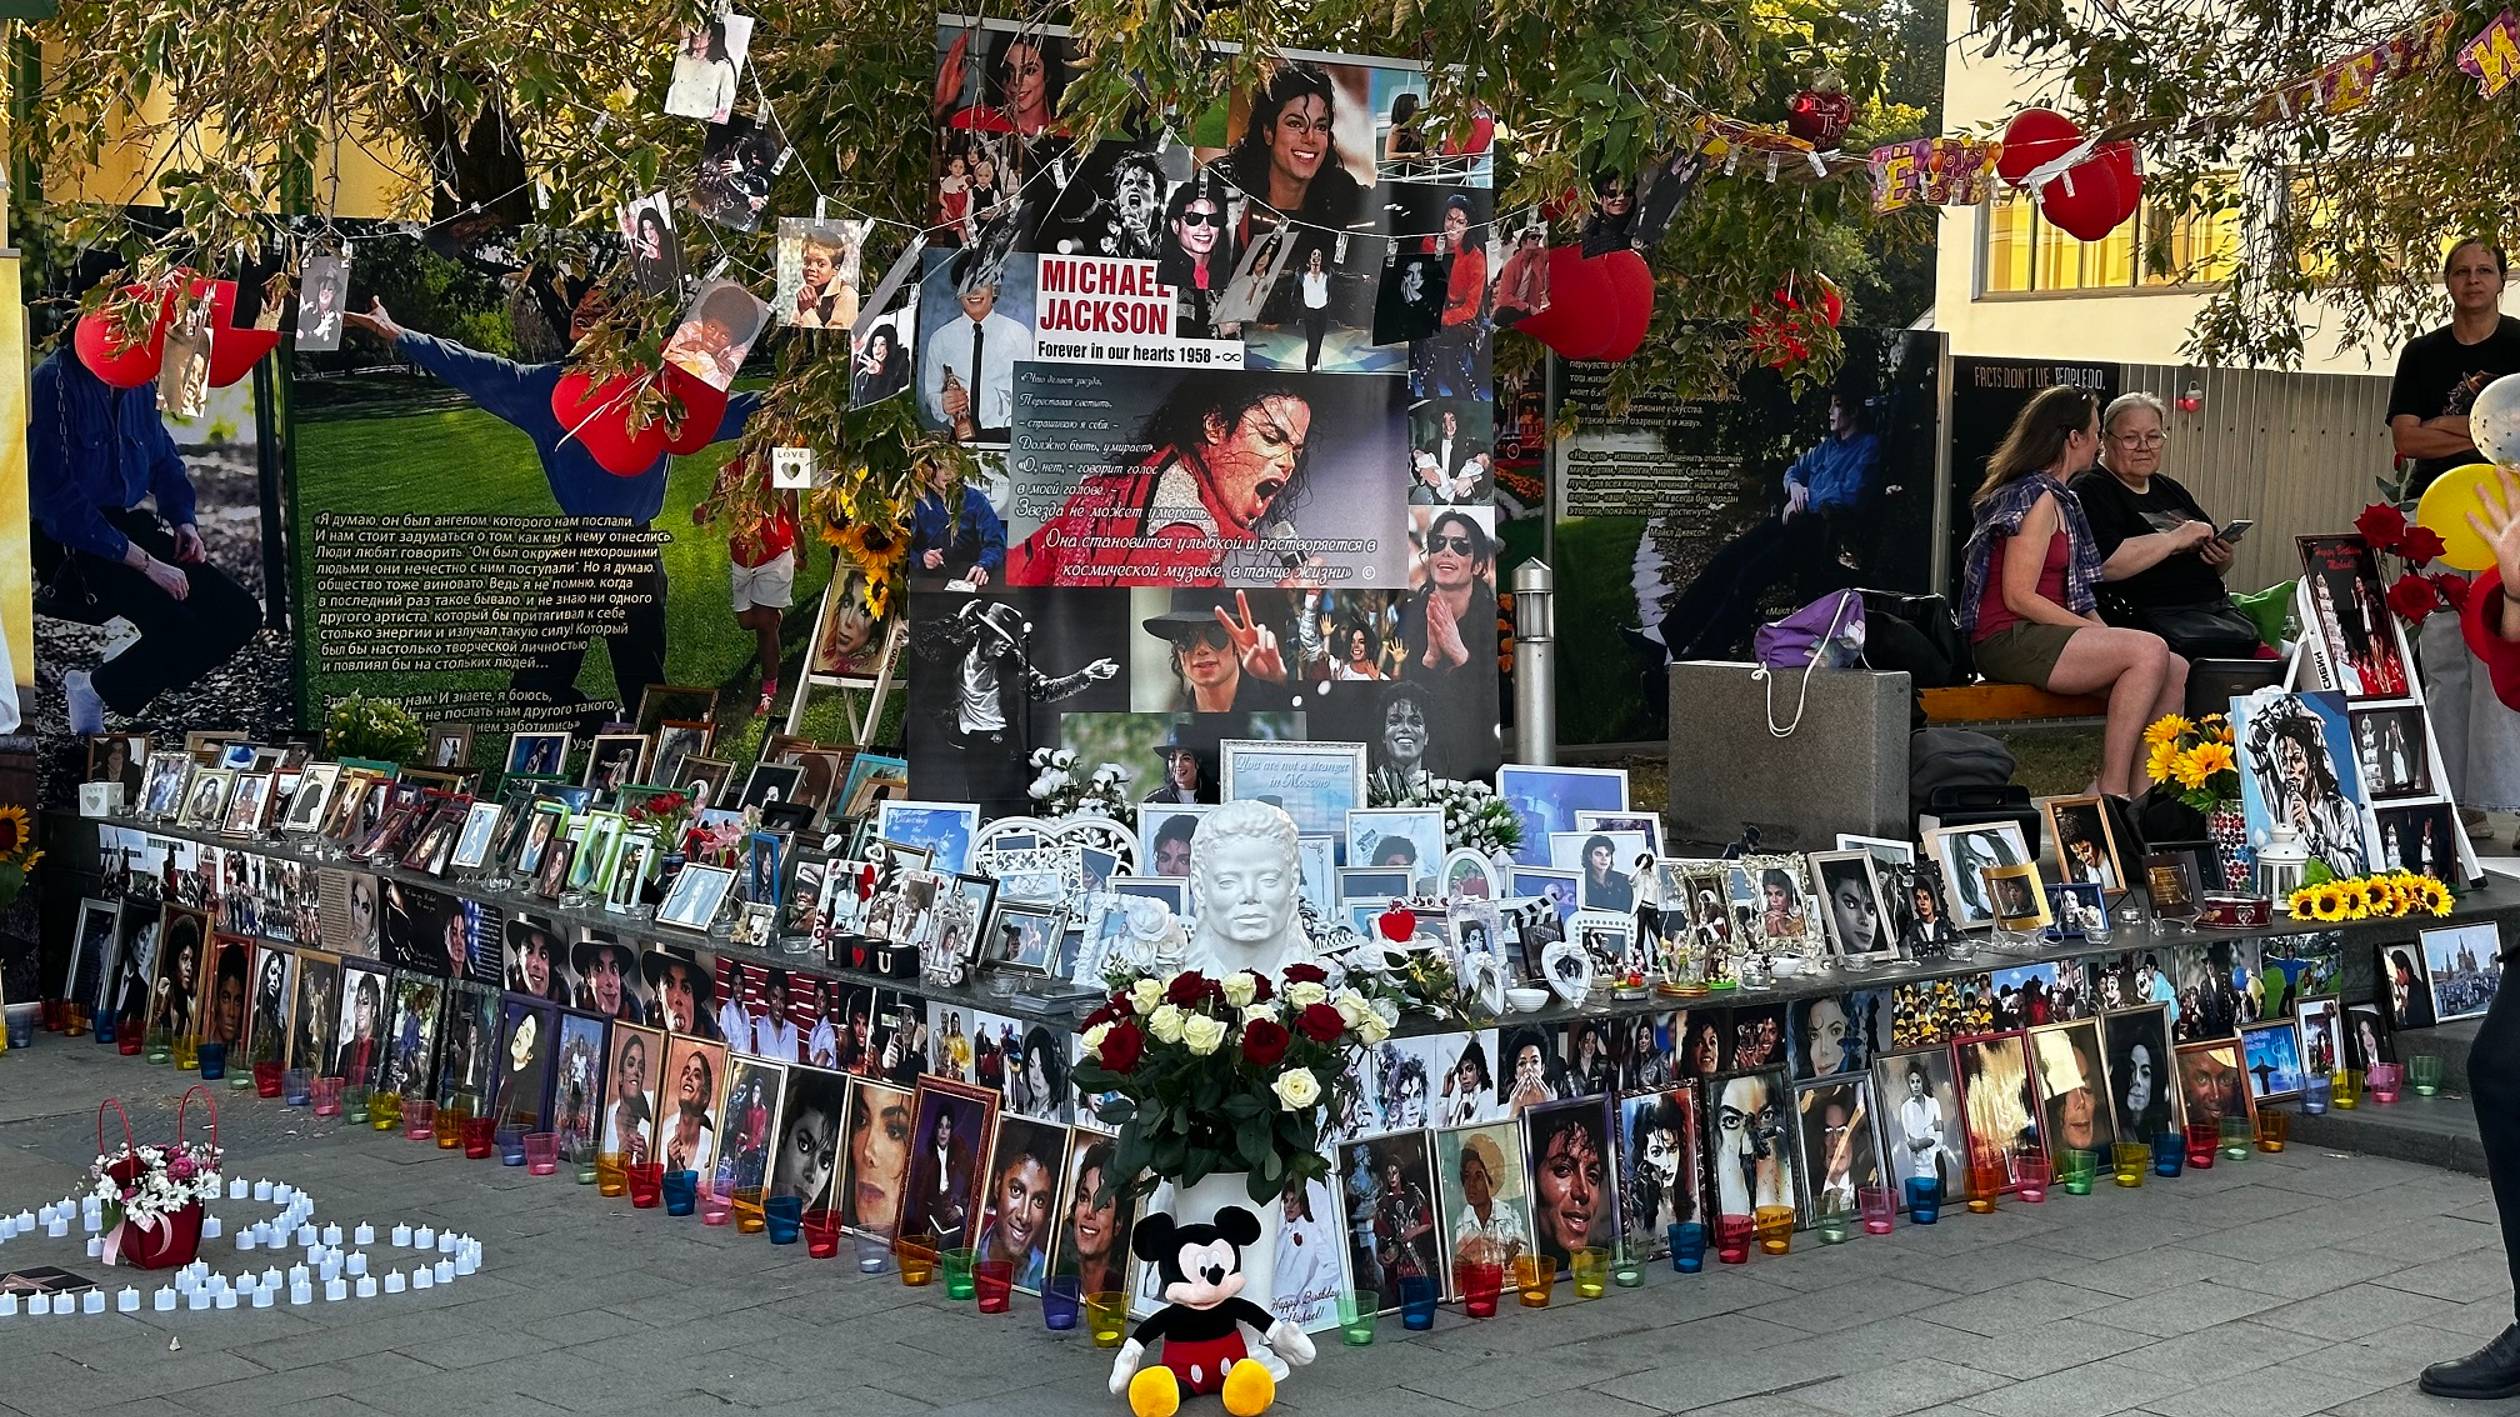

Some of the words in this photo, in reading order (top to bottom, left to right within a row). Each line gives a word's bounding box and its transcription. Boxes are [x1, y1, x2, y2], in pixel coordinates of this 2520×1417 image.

[1041, 259, 1170, 298] MICHAE
[1040, 299, 1169, 336] JACKSON
[1038, 341, 1087, 358] Forever
[1090, 343, 1104, 358] in
[1107, 346, 1130, 360] our
[1133, 345, 1175, 362] hearts
[1180, 348, 1211, 364] 1958
[1974, 366, 2002, 387] FACTS
[2004, 367, 2031, 388] DON'T
[1079, 421, 1086, 429] я
[1018, 435, 1067, 451] Должно
[1069, 440, 1099, 452] быть,
[1040, 463, 1065, 474] нет,
[1077, 463, 1123, 475] говорит
[1127, 464, 1159, 475] голос
[1016, 484, 1024, 495] в
[1029, 483, 1060, 495] моей
[1016, 498, 1063, 521] Звезда
[1069, 505, 1085, 518] не
[1090, 502, 1142, 518] может
[1148, 507, 1211, 520] умереть.
[382, 516, 400, 526] он
[403, 514, 430, 526] был
[493, 517, 551, 529] которого
[554, 518, 579, 526] нам
[315, 530, 326, 541] И
[329, 531, 354, 542] нам
[358, 531, 395, 542] стоит
[400, 532, 474, 545] задуматься
[477, 532, 486, 542] о
[518, 533, 540, 543] как
[543, 533, 562, 543] мы
[564, 533, 572, 542] к
[575, 532, 606, 544] нему
[1046, 528, 1077, 548] Она
[1082, 536, 1171, 549] становится
[1177, 535, 1241, 554] улыбкой
[1245, 541, 1255, 549] и
[1258, 539, 1362, 555] растворяется
[1367, 540, 1377, 552] в
[315, 545, 350, 560] Люди
[493, 546, 518, 558] был
[522, 549, 576, 561] окружен
[580, 547, 658, 560] нехорошими
[375, 564, 400, 574] они
[404, 563, 467, 575] нечестно
[470, 564, 477, 573] с
[479, 563, 505, 573] ним
[583, 561, 600, 573] Но
[603, 563, 611, 573] я
[1063, 561, 1160, 577] космической
[1164, 565, 1225, 583] музыке,
[1231, 567, 1239, 578] в
[1243, 566, 1291, 582] танце
[1294, 564, 1352, 585] жизни»
[317, 579, 382, 592] общество
[385, 582, 419, 591] тоже
[489, 577, 519, 591] Ведь
[523, 580, 531, 590] я
[534, 580, 549, 590] не
[600, 578, 634, 590] когда
[318, 597, 326, 606] в
[330, 595, 402, 607] последний
[406, 597, 431, 609] раз
[435, 596, 471, 605] такое
[525, 597, 535, 606] и
[538, 596, 553, 606] не
[556, 594, 587, 605] знаю
[589, 594, 605, 604] ни
[609, 594, 652, 606] одного
[318, 613, 371, 626] другого
[434, 609, 489, 624] который
[492, 608, 509, 620] бы
[513, 609, 584, 624] притягивал
[587, 610, 594, 619] к
[597, 607, 626, 619] себе
[320, 628, 372, 640] столько
[375, 628, 432, 641] энергии
[435, 628, 445, 639] и
[448, 626, 498, 638] излучал
[501, 626, 539, 639] такую
[575, 622, 629, 636] Который
[321, 643, 346, 656] был
[348, 642, 367, 655] бы
[370, 643, 442, 655] настолько
[445, 640, 518, 655] творческой
[520, 640, 588, 653] личностью
[322, 662, 330, 672] и
[333, 660, 389, 672] повлиял
[391, 658, 411, 671] бы
[414, 659, 431, 670] на
[435, 658, 491, 669] стольких
[439, 692, 450, 704] И
[453, 691, 495, 703] знаете,
[498, 691, 506, 701] я
[509, 688, 552, 702] боюсь,
[426, 711, 442, 721] не
[444, 707, 493, 719] послать
[496, 707, 521, 717] нам
[523, 705, 572, 719] другого
[575, 700, 618, 713] такого,
[476, 722, 500, 732] нем
[504, 719, 581, 732] заботились»
[1281, 760, 1297, 772] not
[1300, 763, 1308, 771] a
[1309, 760, 1350, 774] stranger
[1269, 777, 1281, 788] in
[1282, 773, 1330, 789] Moscow
[877, 951, 892, 974] U
[1271, 1295, 1300, 1314] Happy
